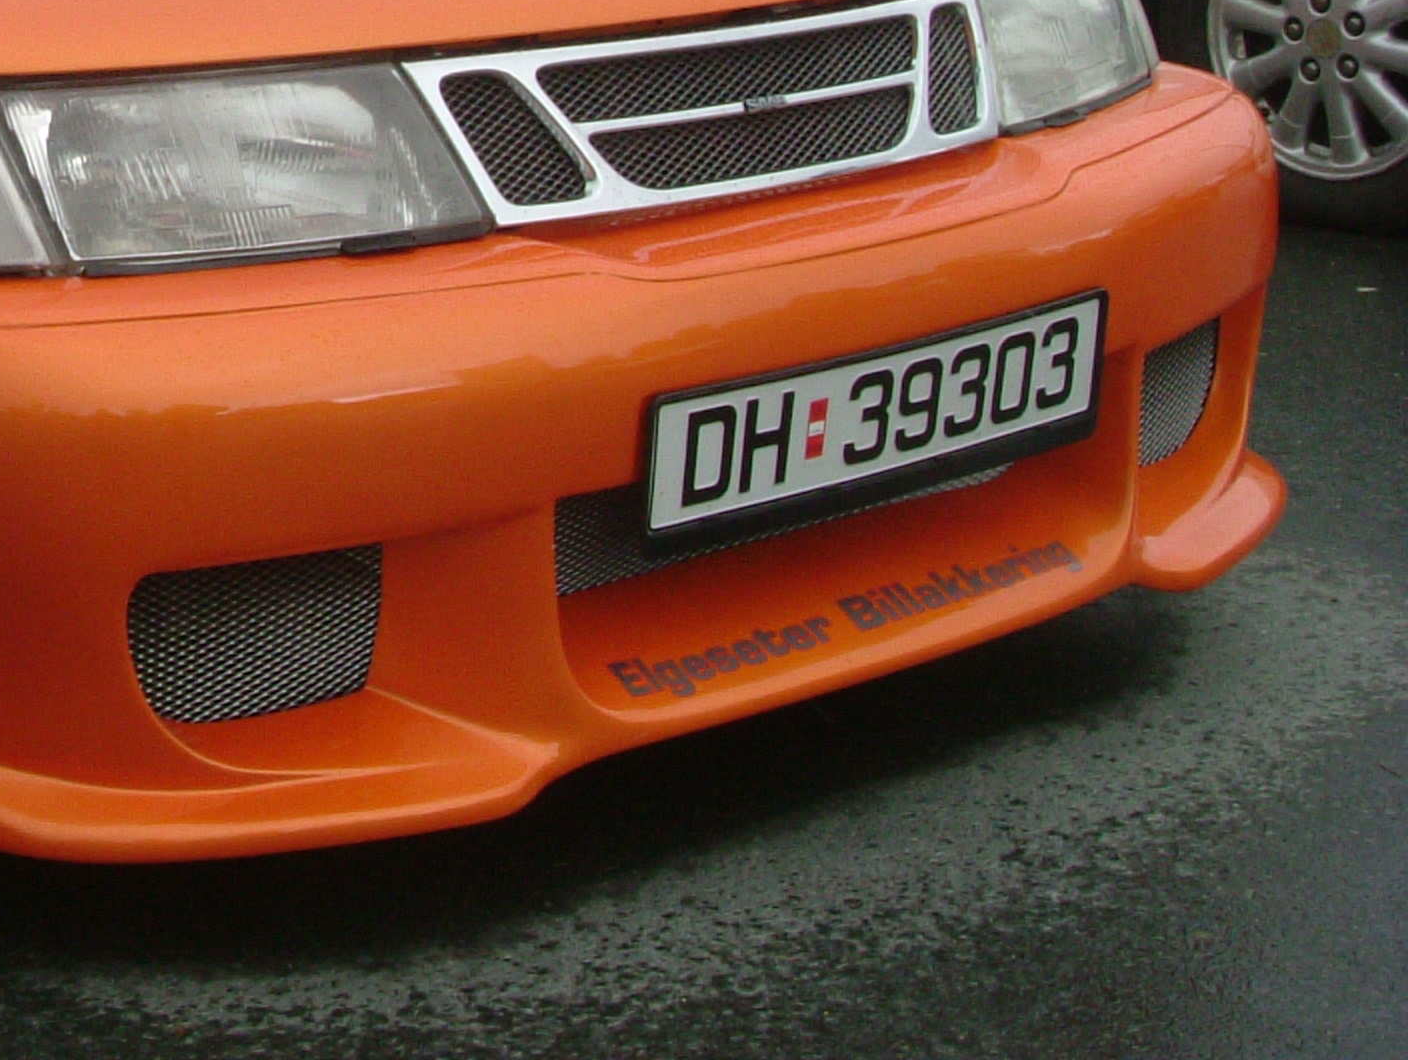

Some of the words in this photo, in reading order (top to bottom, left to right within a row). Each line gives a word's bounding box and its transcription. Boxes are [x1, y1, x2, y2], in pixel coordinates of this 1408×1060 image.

[680, 391, 796, 508] DH
[842, 316, 1080, 466] 39303
[607, 613, 831, 699] Elgeseter
[837, 540, 1085, 632] Billakkering
